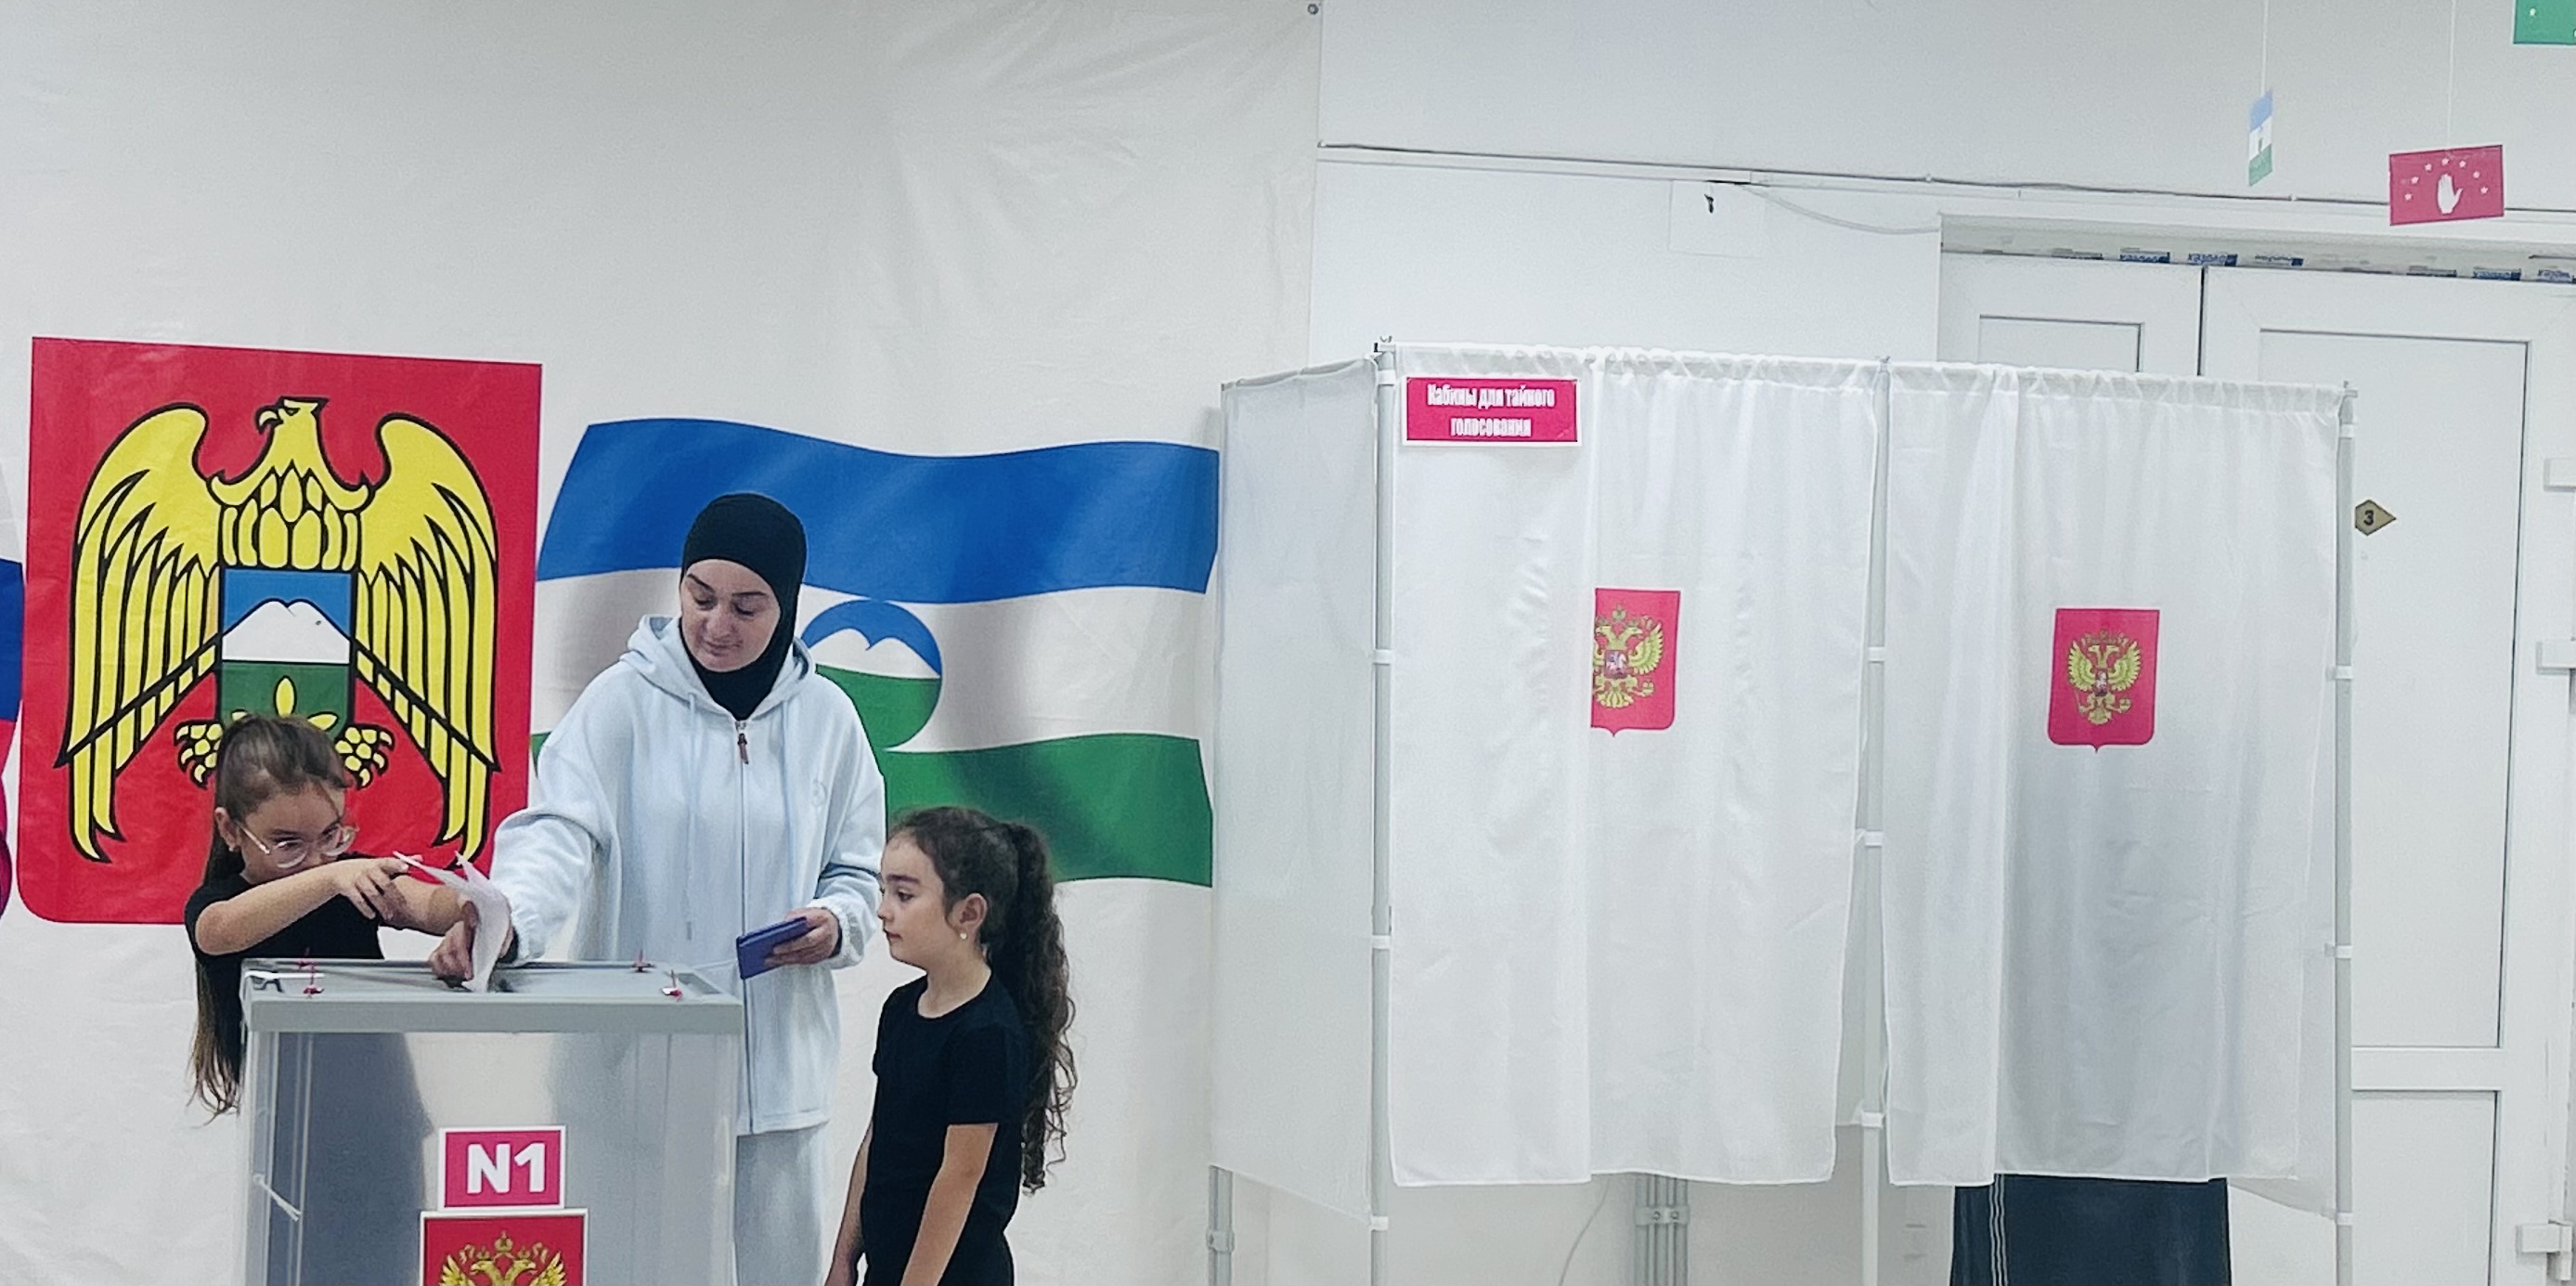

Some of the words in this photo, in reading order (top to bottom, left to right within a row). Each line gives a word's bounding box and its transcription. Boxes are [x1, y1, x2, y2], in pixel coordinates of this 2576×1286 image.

[1427, 383, 1477, 406] Кабины
[1478, 387, 1505, 409] для
[1506, 384, 1556, 408] тайного
[1450, 417, 1532, 437] голосования
[2363, 509, 2375, 526] 3
[467, 1142, 546, 1194] N1
